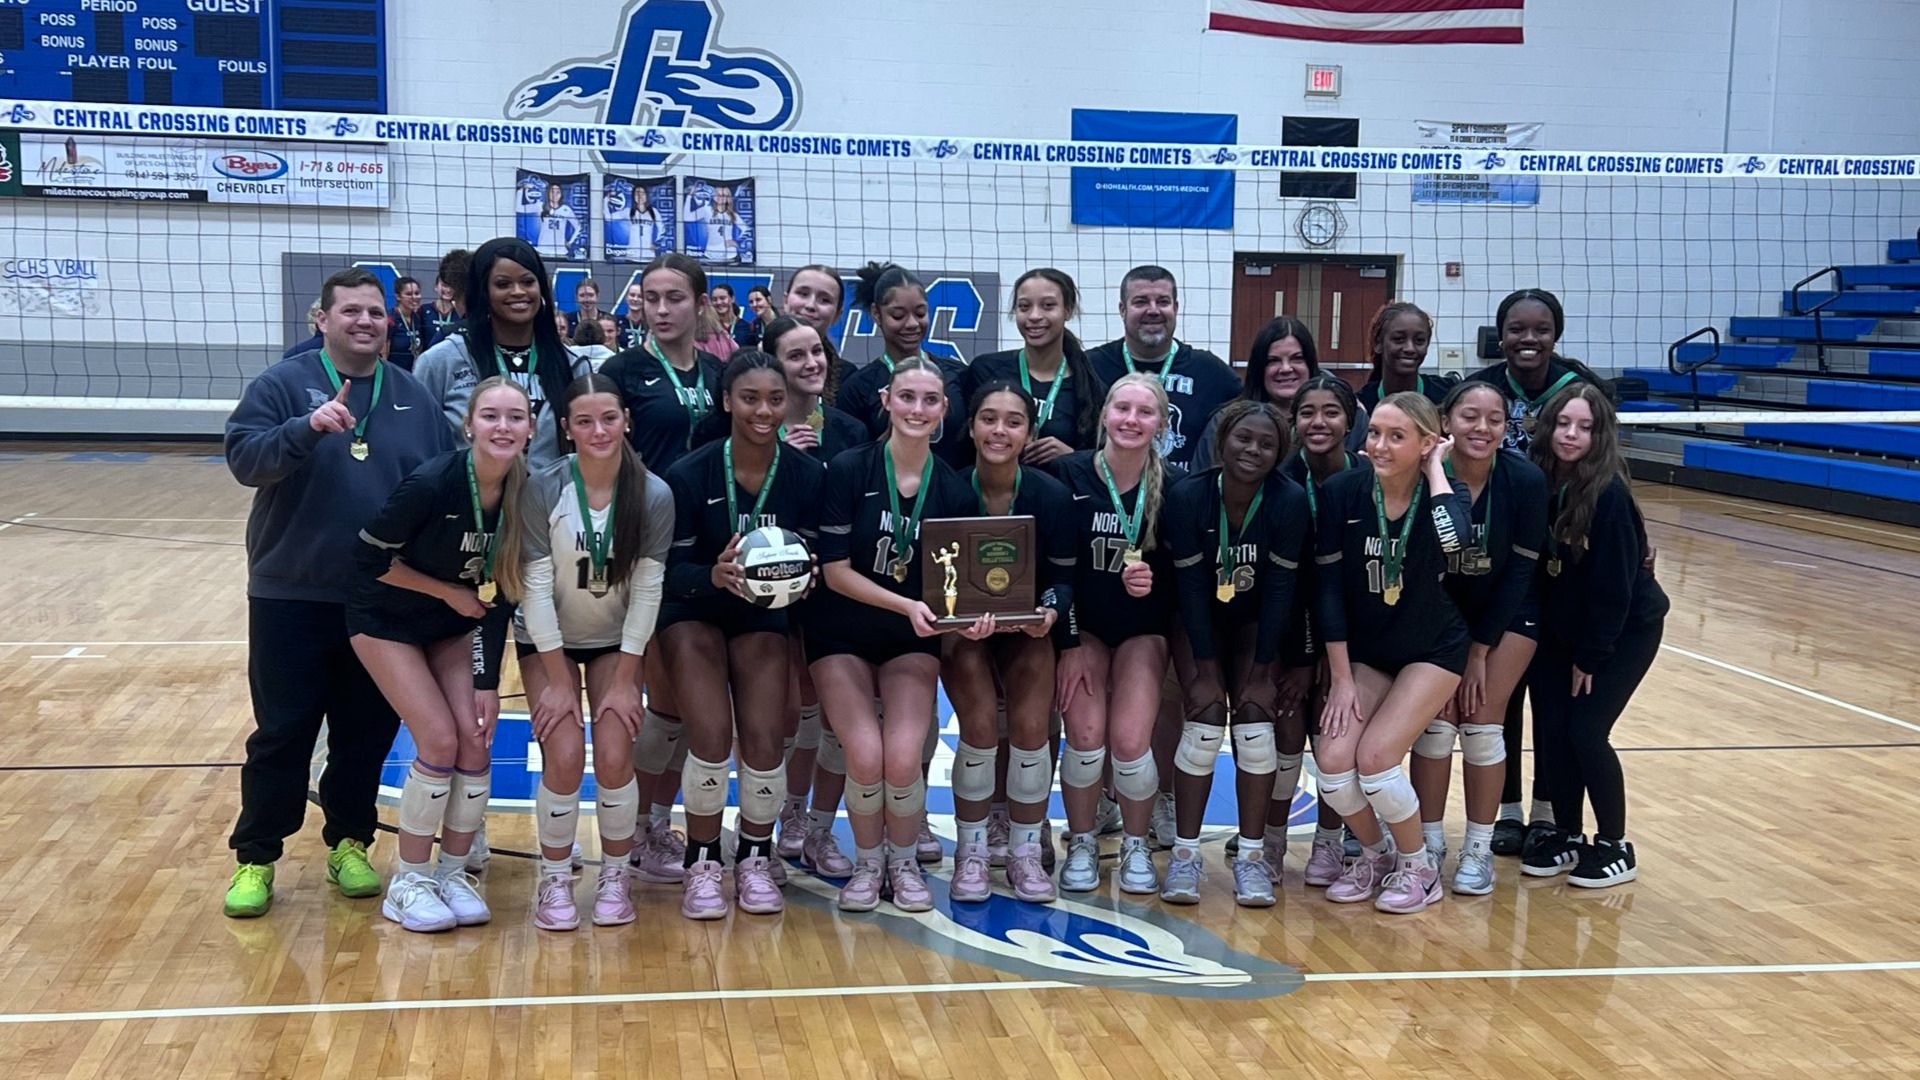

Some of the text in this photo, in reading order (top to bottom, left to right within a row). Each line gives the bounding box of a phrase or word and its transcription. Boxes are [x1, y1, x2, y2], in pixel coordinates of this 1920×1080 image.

[81, 0, 137, 12] PERIOD
[187, 0, 264, 13] GUEST
[40, 13, 76, 26] POSS
[142, 17, 177, 30] POSS
[41, 35, 85, 48] BONUS
[134, 38, 178, 52] BONUS
[68, 54, 177, 70] PLAYER FOUL
[218, 60, 267, 73] FOULS
[1314, 71, 1333, 87] EXIT
[54, 109, 306, 135] CENTRAL CROSSING COMETS
[376, 121, 618, 146] CENTRAL CROSSING COMETS
[683, 133, 910, 157] CENTRAL CROSSING COMETS
[974, 143, 1191, 165] CENTRAL CROSSING COMETS
[1252, 150, 1461, 170] CENTRAL CROSSING COMETS
[221, 155, 278, 174] Byers
[300, 161, 383, 174] I-71 & OH-665
[1520, 155, 1723, 174] CENTRAL CROSSING COMETS
[1779, 159, 1915, 175] CENTRAL CROSSING
[217, 182, 286, 195] CHEVROLET
[300, 177, 373, 190] Intersection
[4, 258, 96, 276] CCHS VBALL
[1431, 504, 1462, 554] PANTHERS
[873, 536, 914, 576] 12
[1091, 537, 1131, 573] 17
[757, 562, 803, 577] molten
